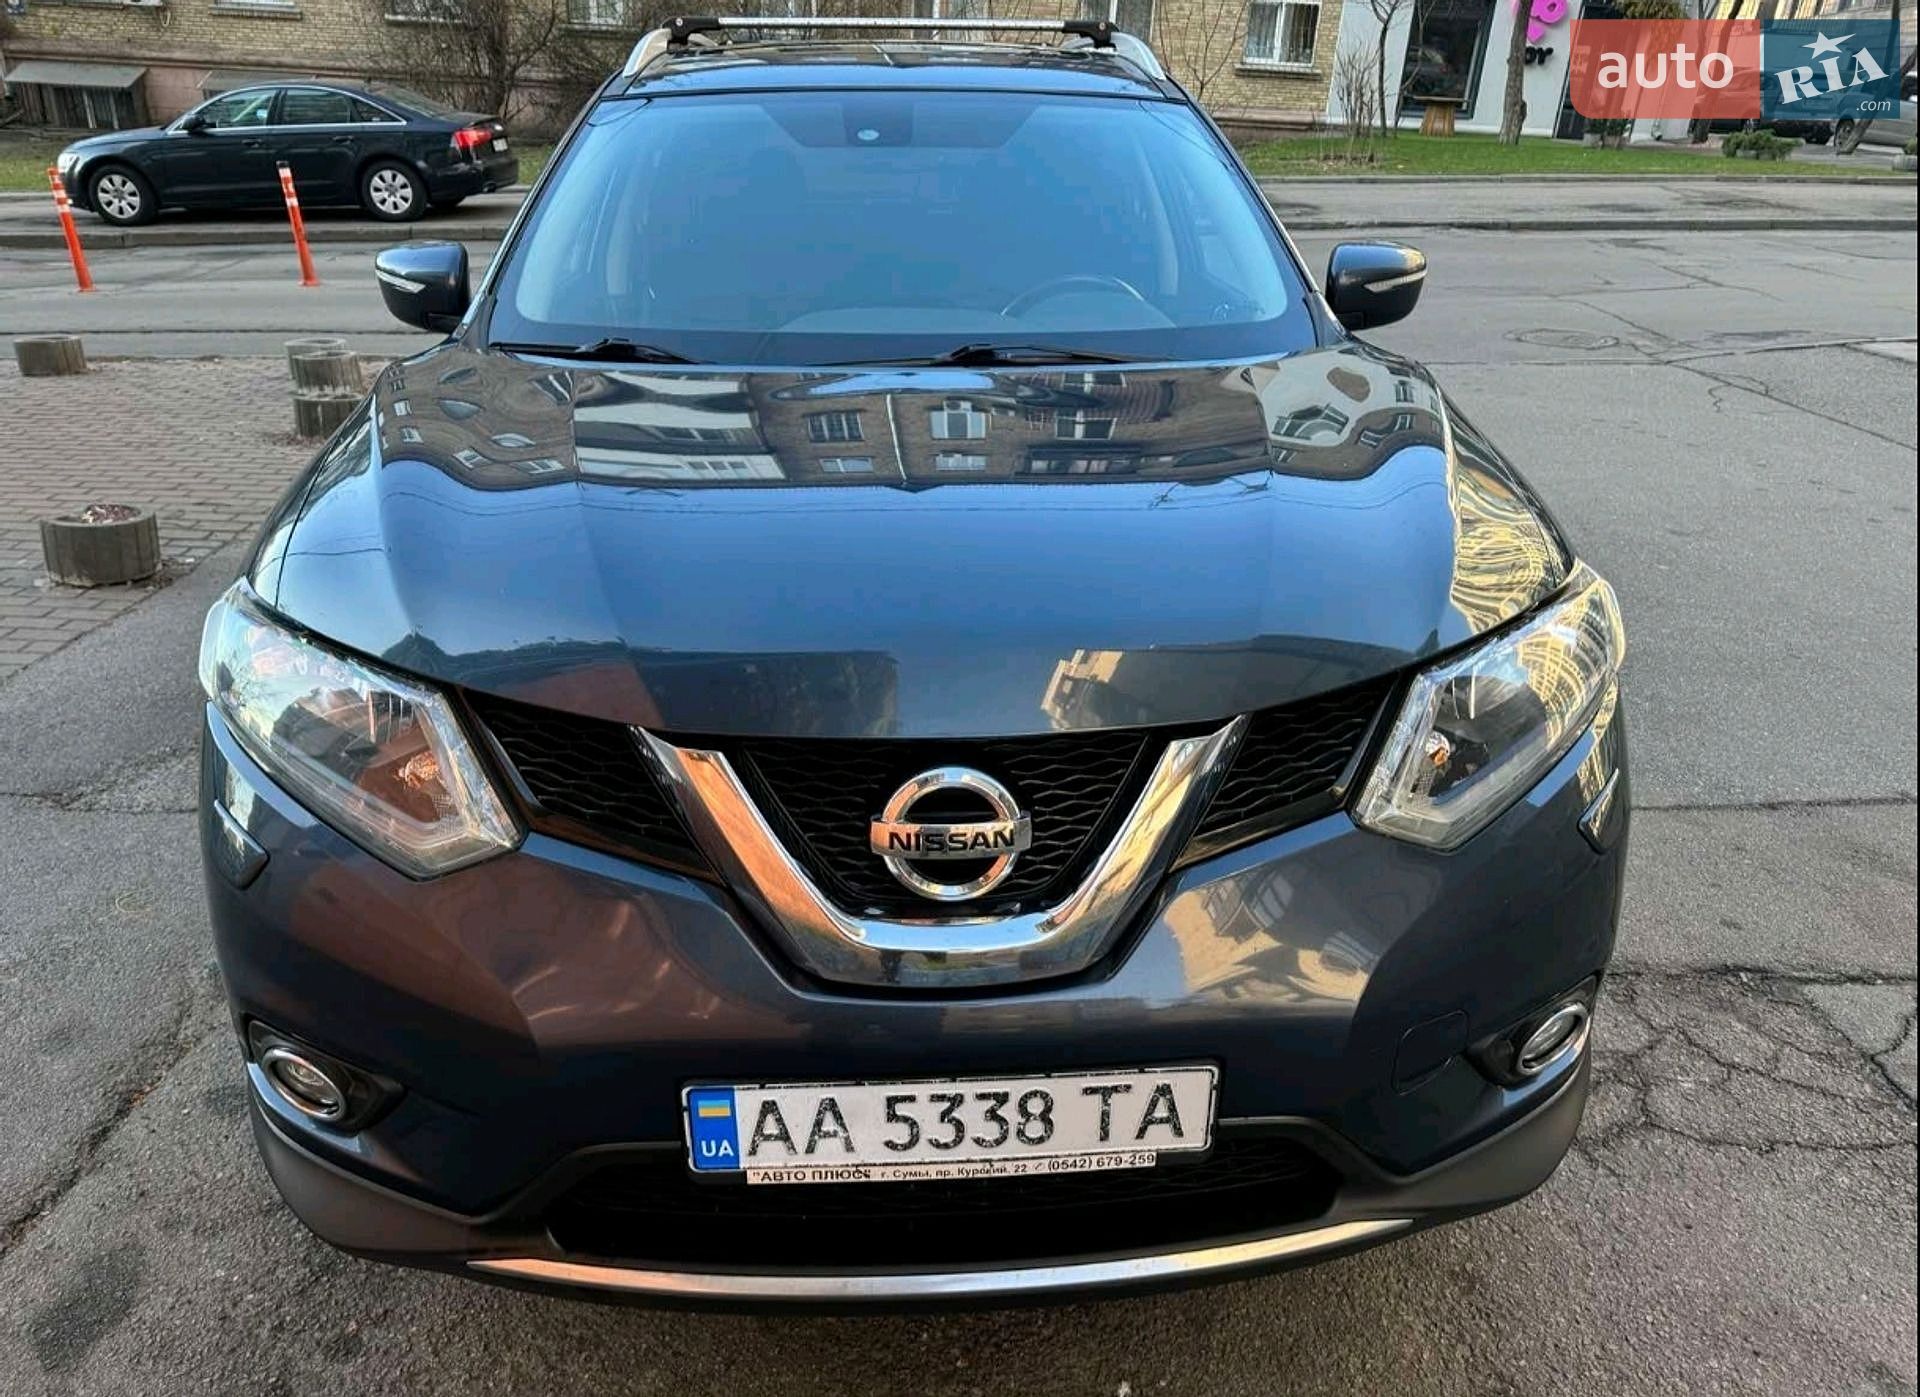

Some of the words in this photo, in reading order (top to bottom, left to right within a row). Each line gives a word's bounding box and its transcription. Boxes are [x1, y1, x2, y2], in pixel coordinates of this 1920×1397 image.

[889, 829, 1015, 851] NISSAN
[748, 1098, 855, 1156] AA
[883, 1089, 1054, 1151] 5338
[1081, 1083, 1184, 1142] TA
[701, 1139, 734, 1157] UA
[1014, 1163, 1027, 1172] 22
[1048, 1158, 1092, 1172] (0542)
[1096, 1154, 1155, 1167] 679-259
